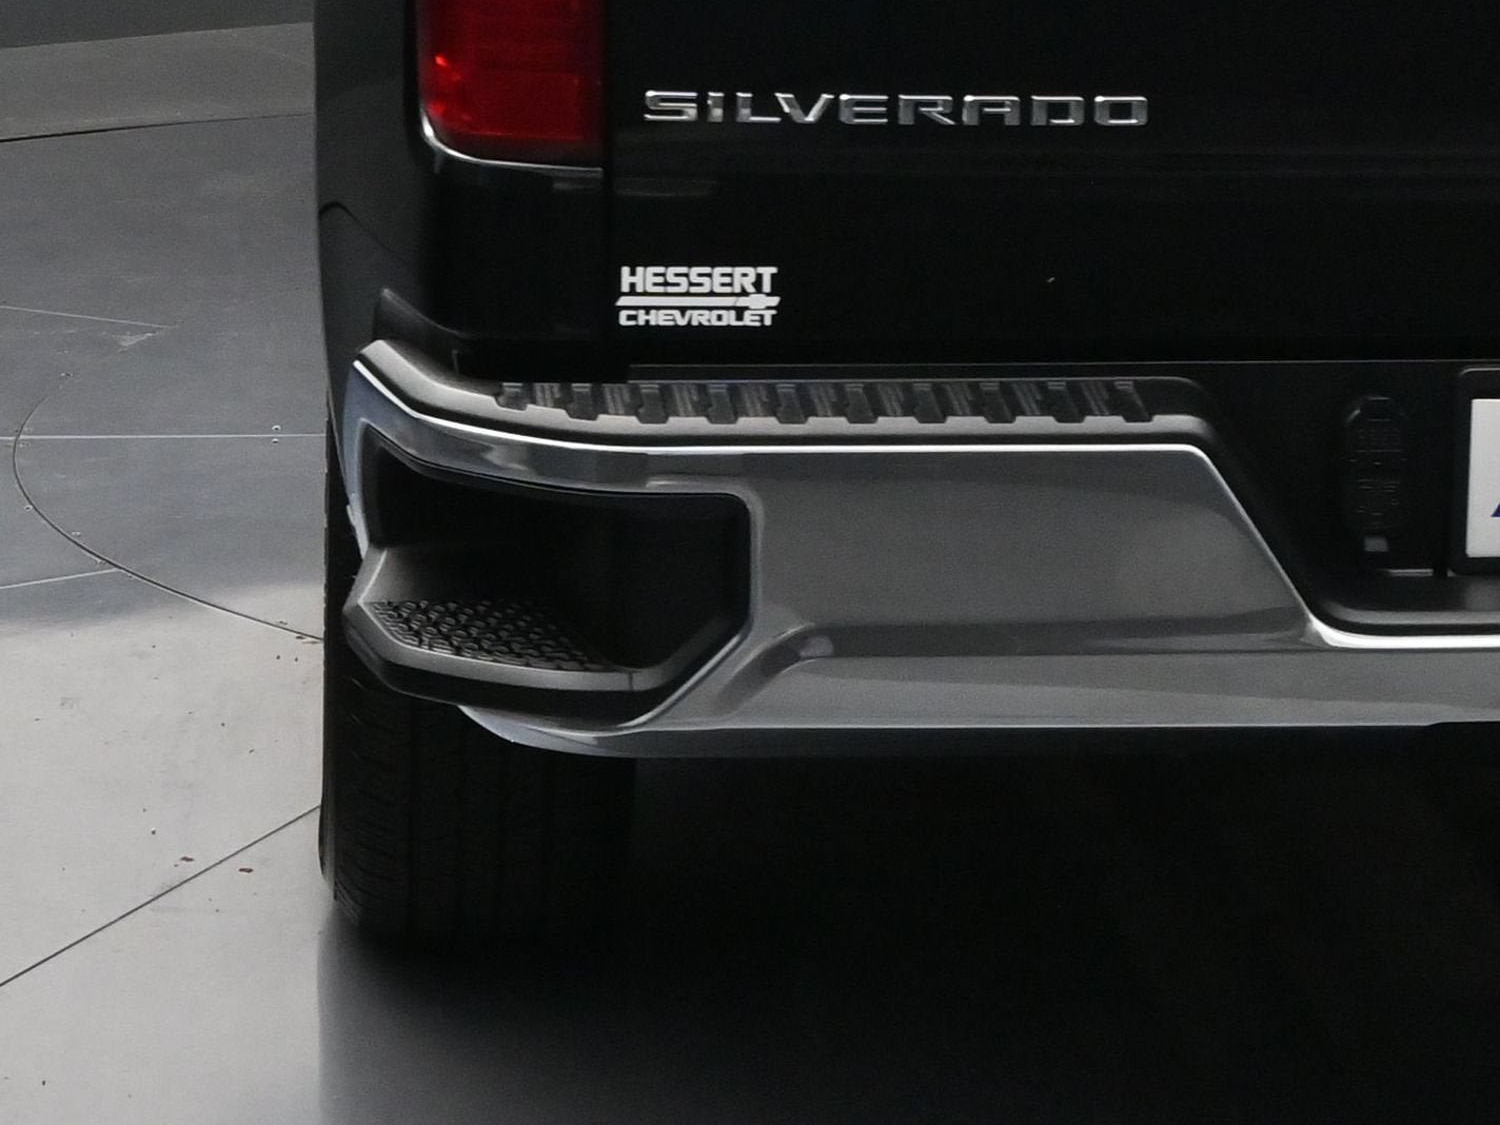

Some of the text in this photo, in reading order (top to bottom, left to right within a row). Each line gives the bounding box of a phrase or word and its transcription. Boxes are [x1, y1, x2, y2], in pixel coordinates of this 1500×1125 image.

[643, 88, 1149, 127] SILVERADO
[620, 266, 779, 294] HESSERT
[618, 309, 778, 327] CHEVROLET
